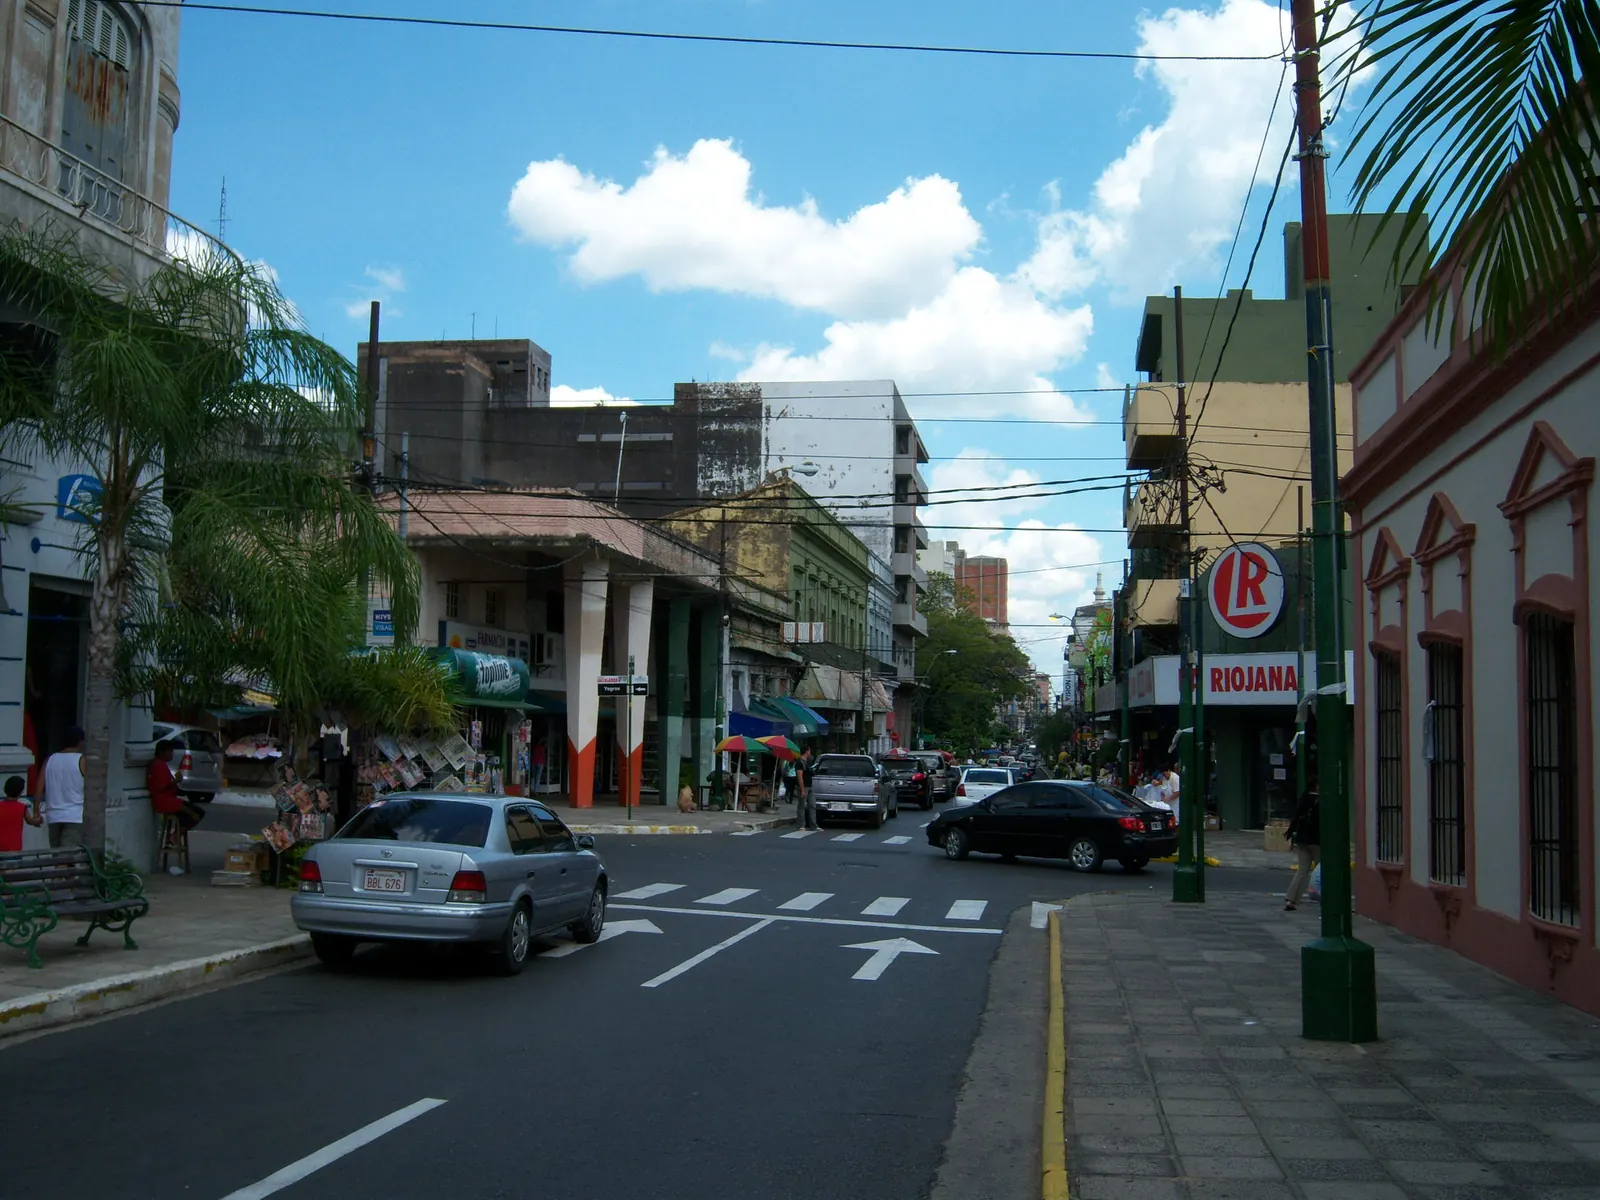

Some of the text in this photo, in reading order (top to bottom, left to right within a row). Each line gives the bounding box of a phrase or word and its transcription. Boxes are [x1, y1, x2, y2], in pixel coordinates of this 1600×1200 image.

[480, 660, 509, 689] topline
[1211, 665, 1298, 692] RIOJANA
[385, 878, 401, 890] 676
